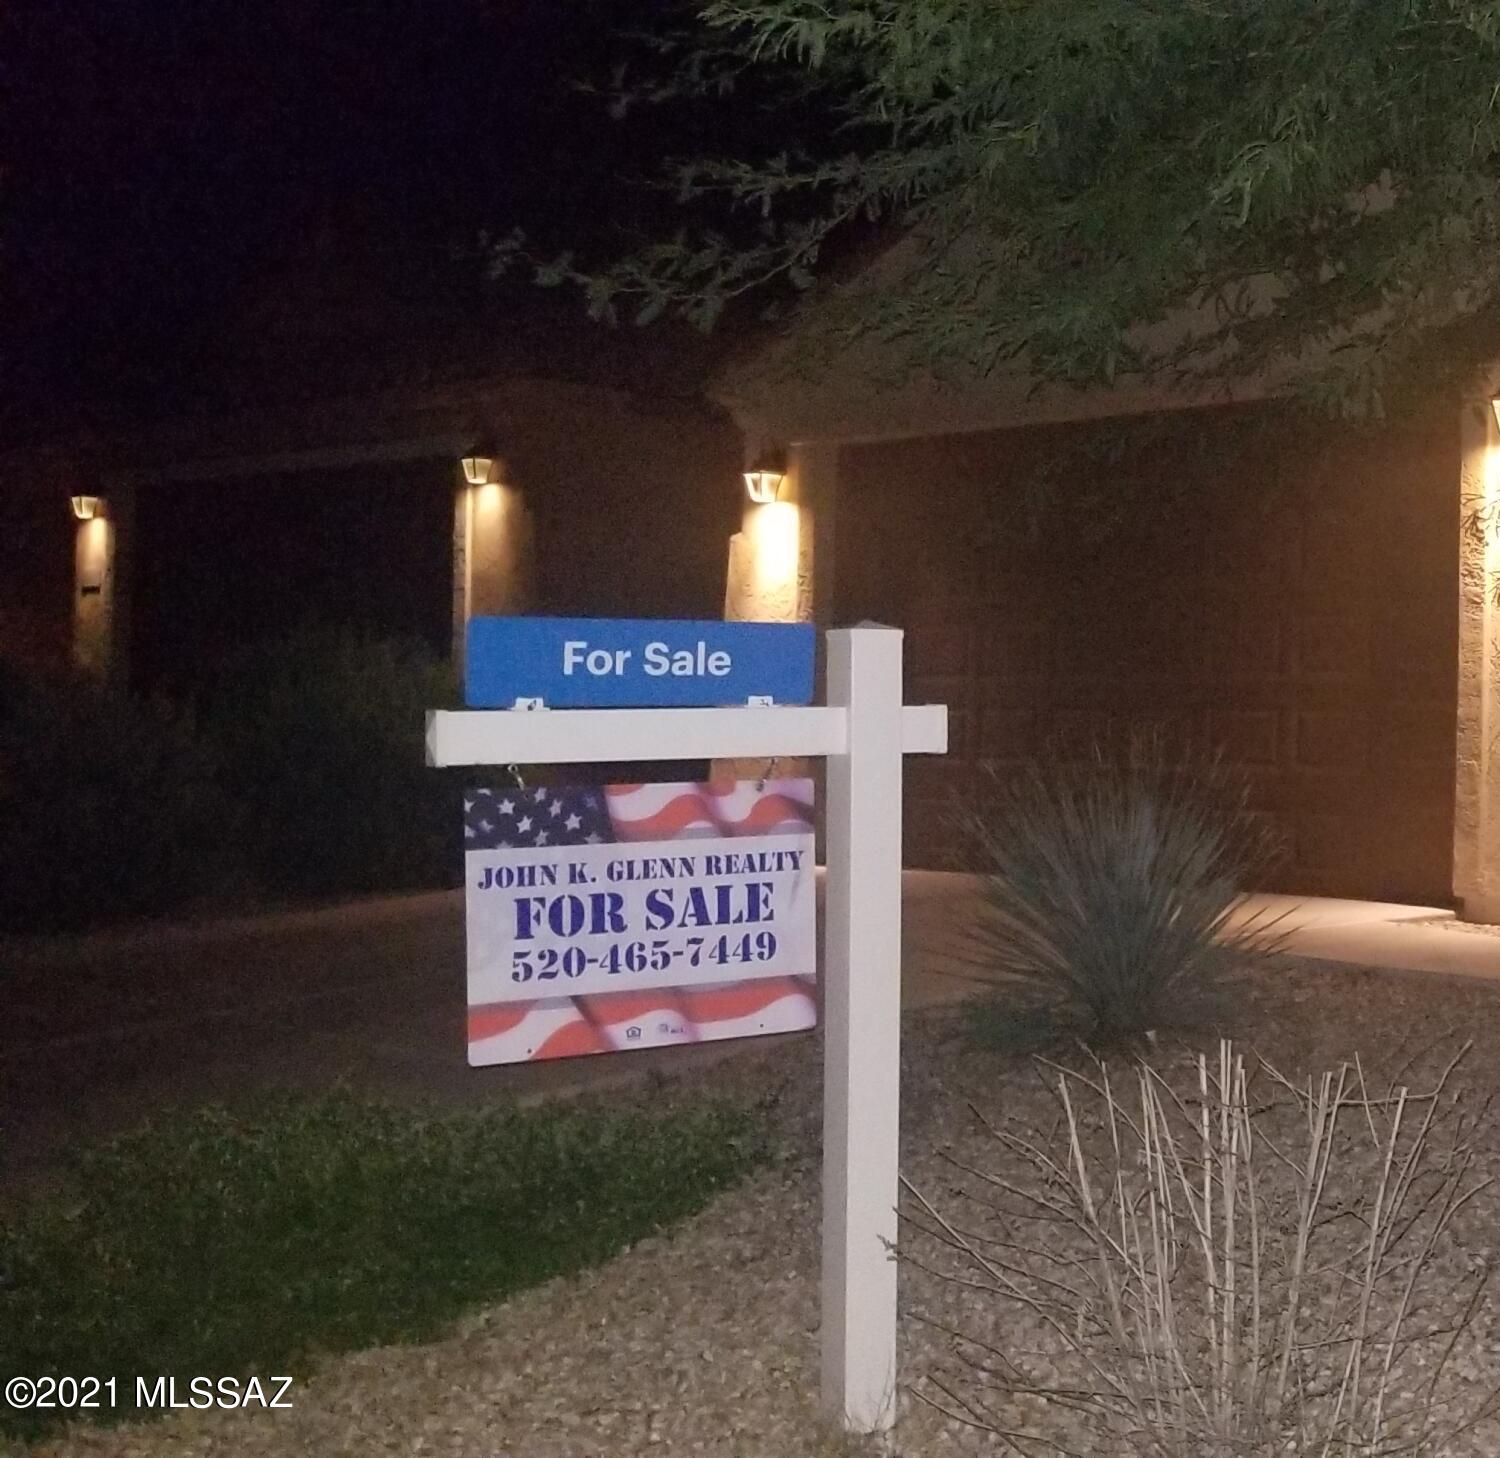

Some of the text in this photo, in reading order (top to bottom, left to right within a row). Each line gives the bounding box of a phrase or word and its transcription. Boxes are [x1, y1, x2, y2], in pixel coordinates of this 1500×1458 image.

[563, 641, 732, 676] For Sale
[478, 850, 804, 890] JOHN K. GLENN REALTY
[513, 882, 774, 940] FOR SALE
[511, 931, 777, 983] 520-465-7449
